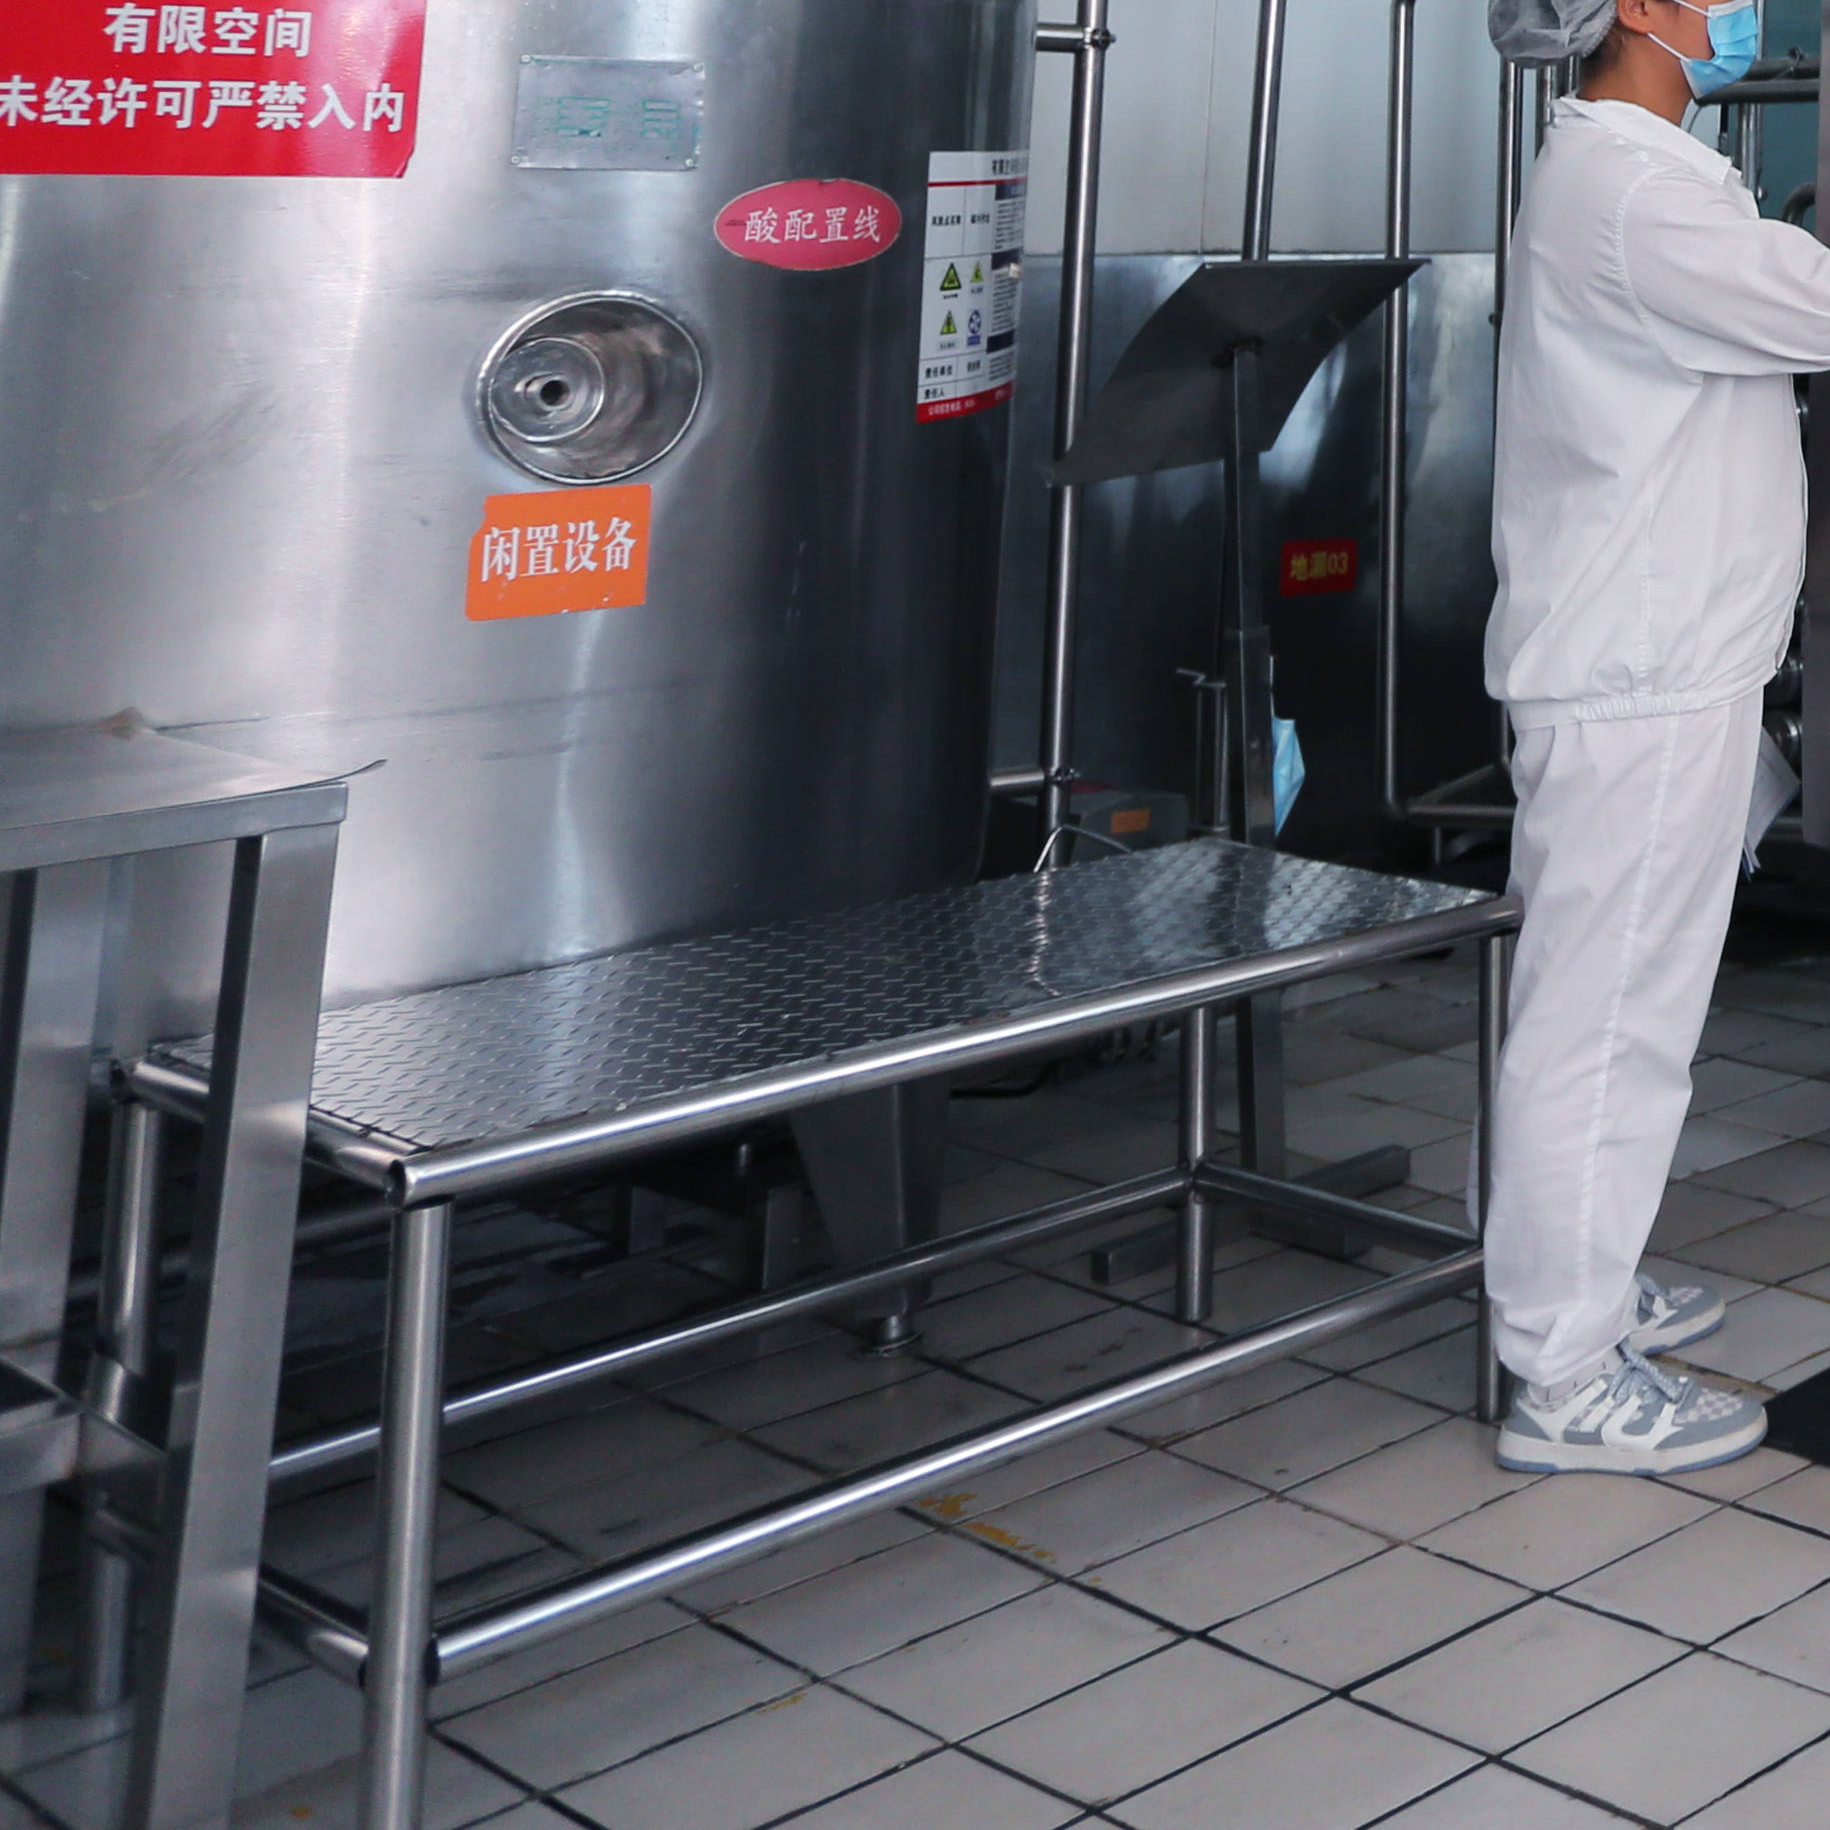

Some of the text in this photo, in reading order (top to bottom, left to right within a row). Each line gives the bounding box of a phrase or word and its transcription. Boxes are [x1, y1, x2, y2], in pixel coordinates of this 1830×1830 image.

[104, 2, 313, 58] 有限空间
[0, 74, 405, 133] 未经许可严禁入内
[481, 515, 637, 583] 闲置设备
